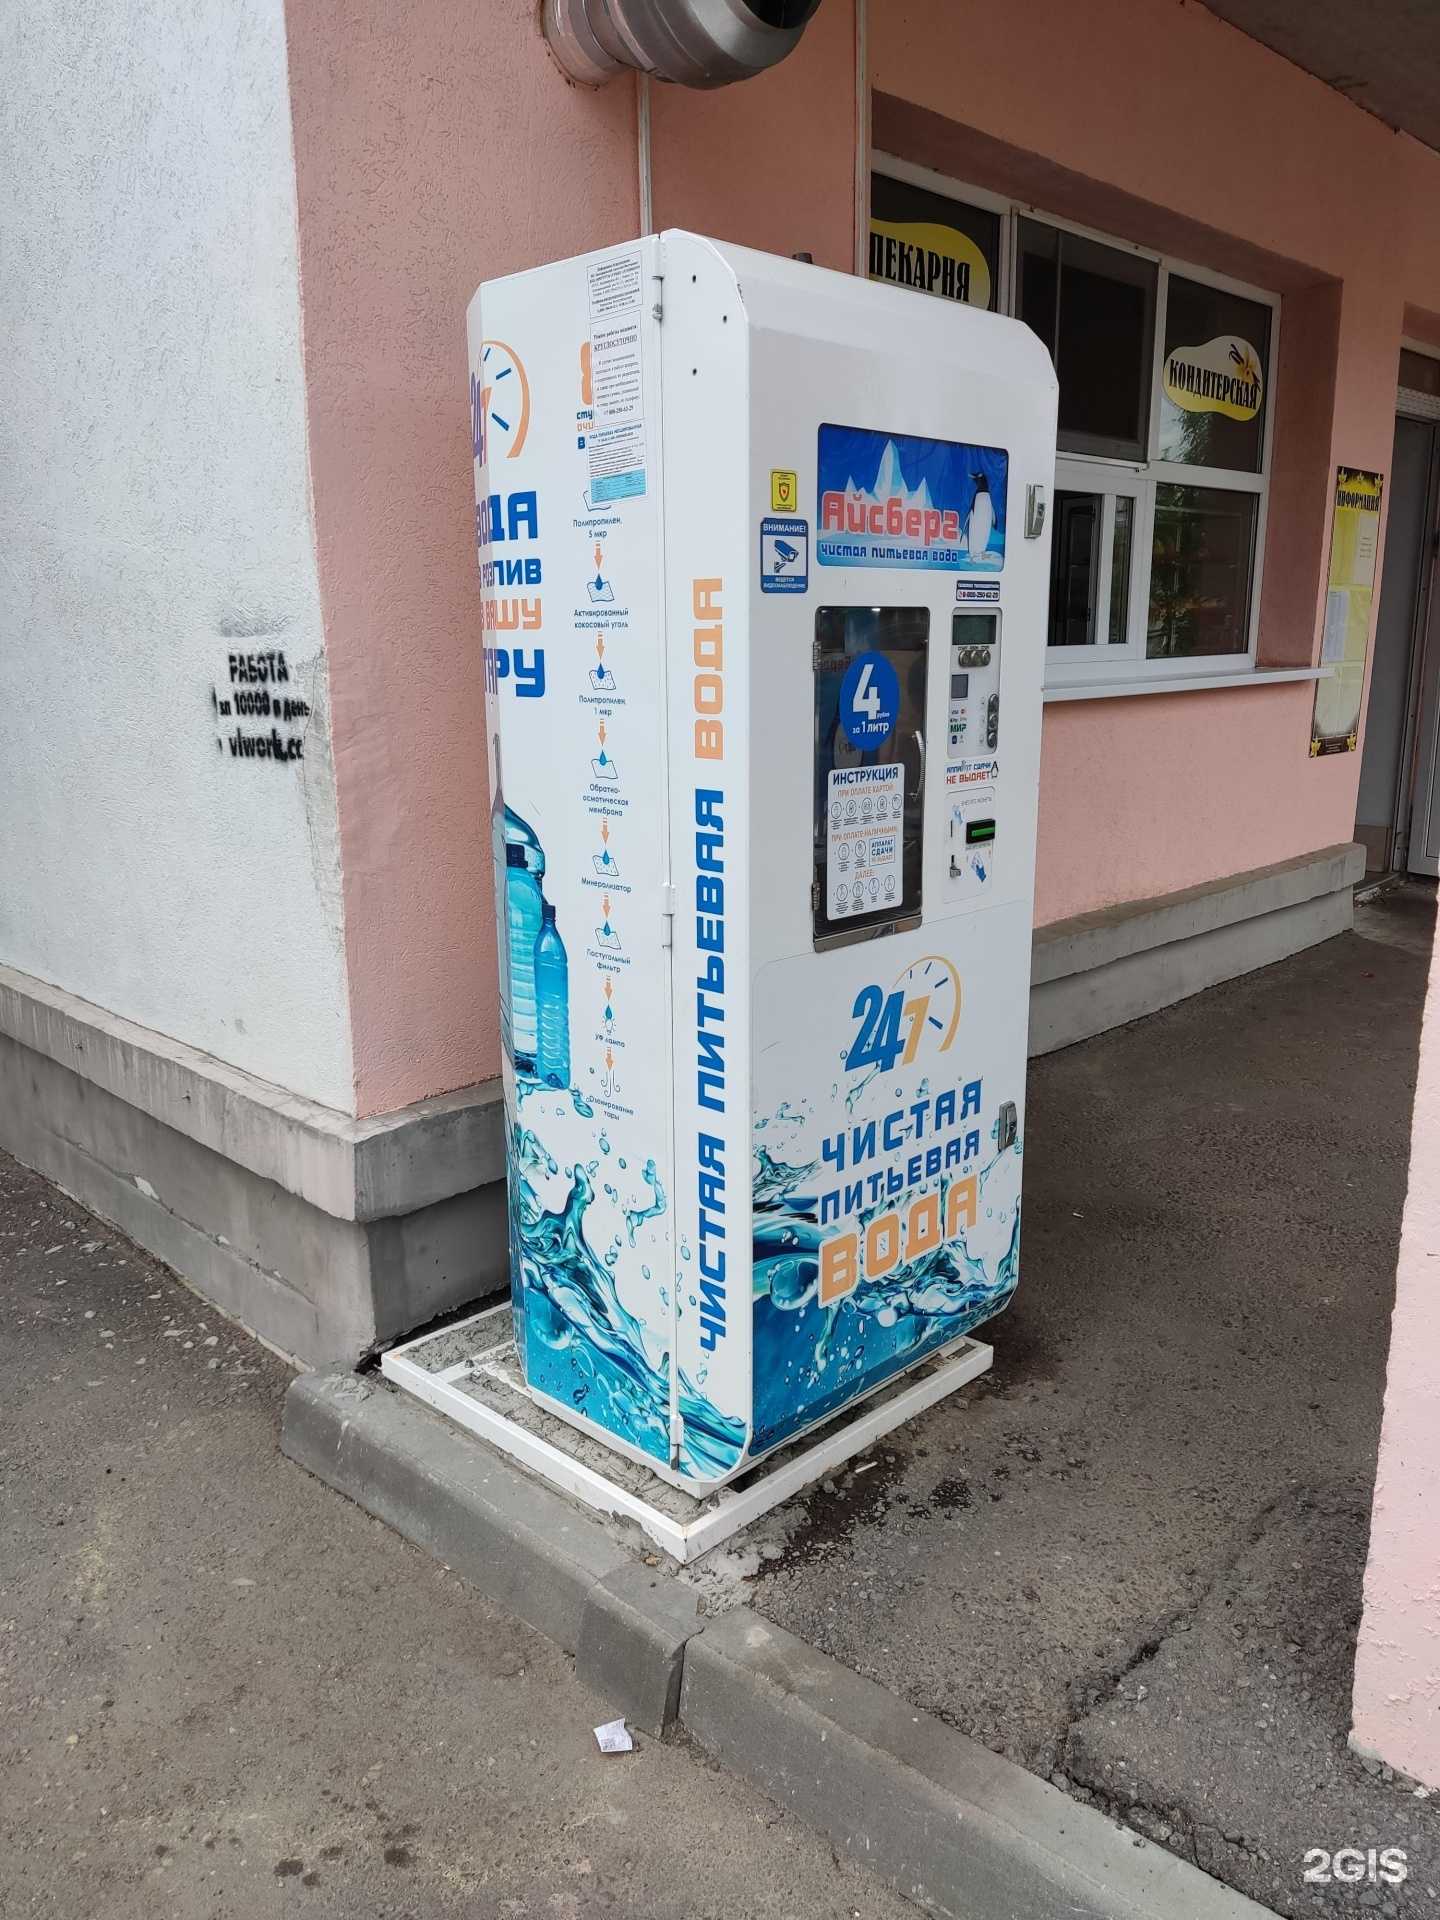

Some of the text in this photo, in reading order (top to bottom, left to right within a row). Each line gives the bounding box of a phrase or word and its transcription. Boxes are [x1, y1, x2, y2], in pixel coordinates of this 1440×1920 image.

[869, 231, 970, 302] ПЕКАРНЯ
[1169, 359, 1258, 410] КОНДИТЕРСКАЯ
[1337, 490, 1380, 512] ИНФОРМАЦИЯ
[821, 490, 960, 546] Айсберг
[594, 530, 608, 539] мкр
[763, 523, 806, 533] ВНИМАНИЕ!
[821, 544, 958, 563] чистая питьевая вода
[574, 607, 629, 617] Активированный
[574, 619, 629, 630] кокосовый уголь
[693, 578, 724, 761] ВОДА
[853, 664, 880, 720] 4
[234, 691, 271, 716] 10000
[862, 721, 866, 733] 1
[867, 722, 890, 735] литр
[950, 723, 967, 733] МИР
[833, 767, 898, 785] ИНСТРУКЦИЯ
[946, 771, 990, 785] НЕ ВЫДАЕТ
[589, 783, 620, 794] Обратно-
[589, 805, 623, 816] мембрана
[871, 847, 893, 856] СДАЧИ
[581, 877, 632, 893] Минерализатор
[695, 788, 725, 1113] ПИТЬЕВАЯ
[822, 1079, 982, 1172] ЧИСТАЯ
[820, 1129, 980, 1225] ПИТЬЕВАЯ
[698, 1132, 727, 1352] ЧИСТАЯ
[822, 1175, 978, 1304] ВОДА
